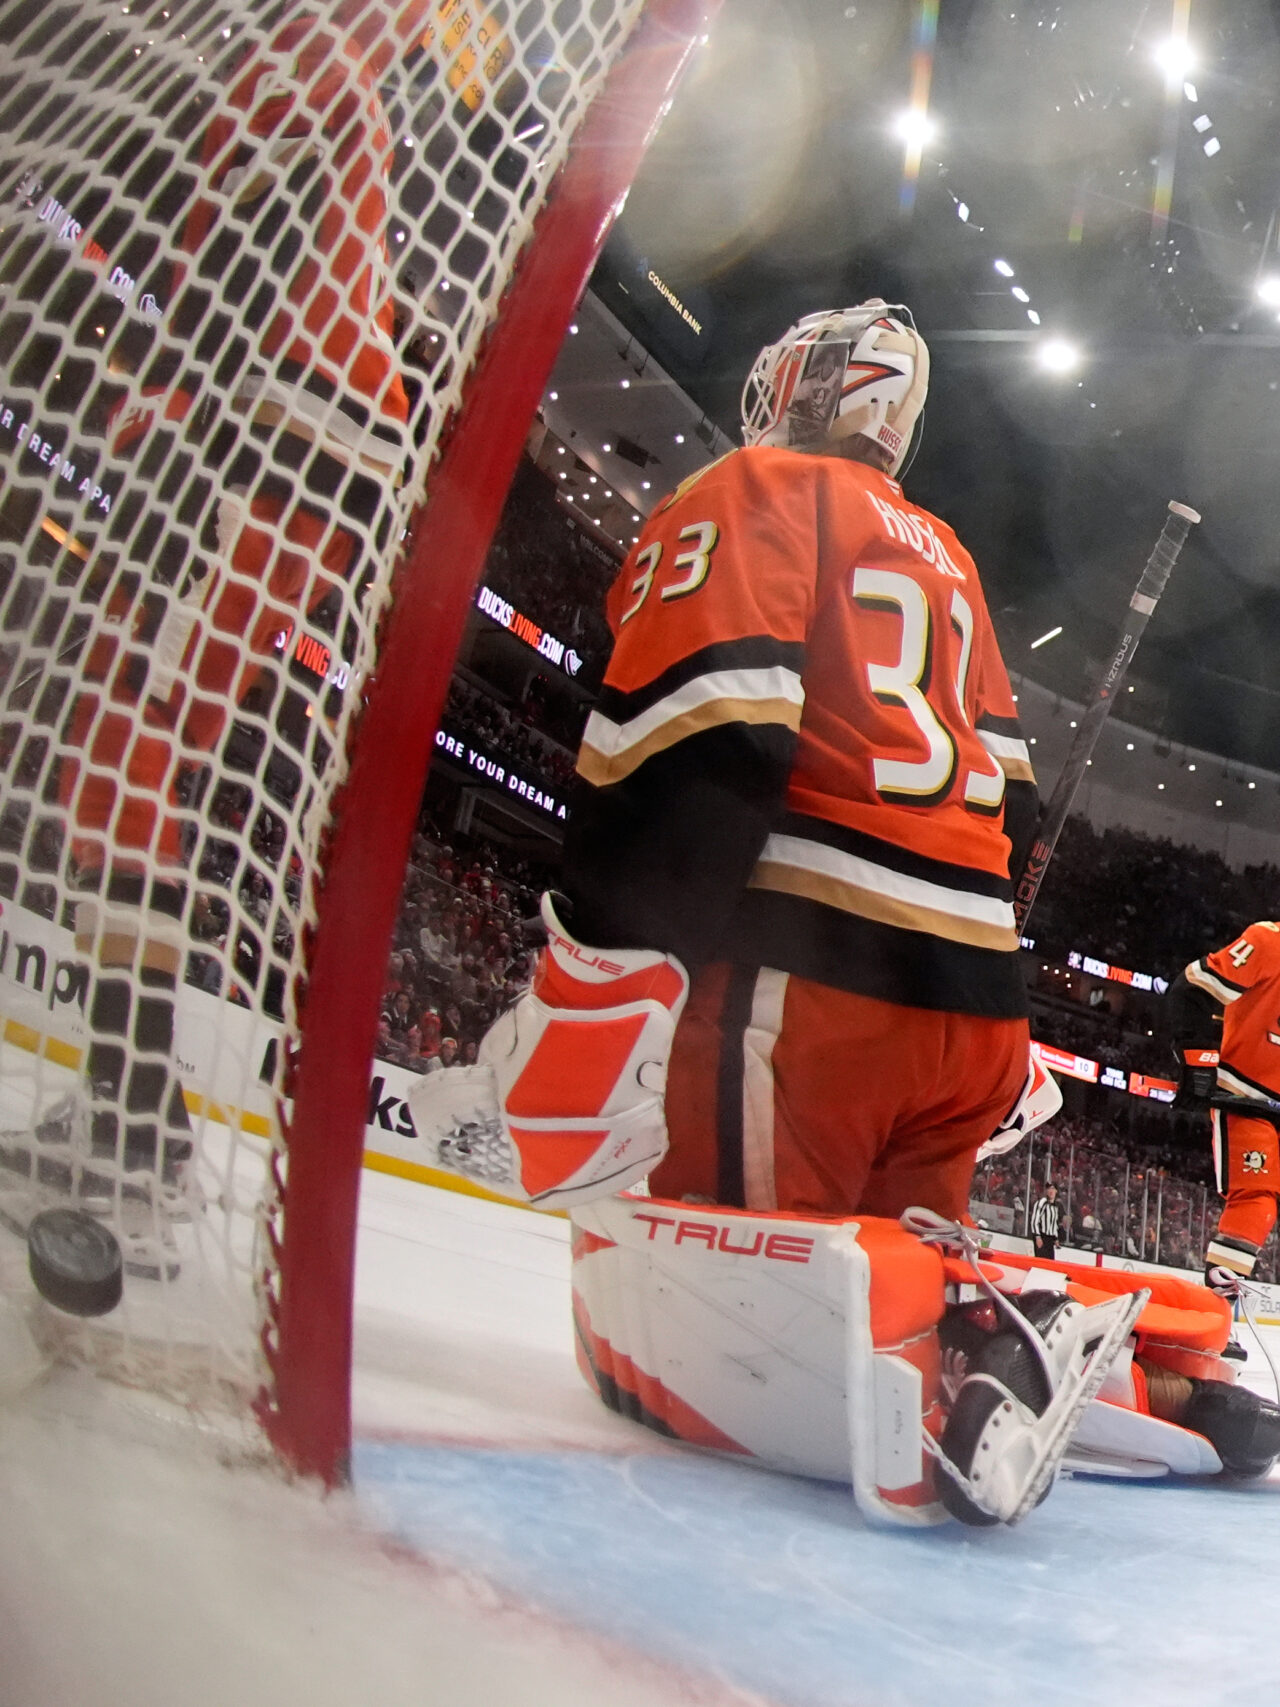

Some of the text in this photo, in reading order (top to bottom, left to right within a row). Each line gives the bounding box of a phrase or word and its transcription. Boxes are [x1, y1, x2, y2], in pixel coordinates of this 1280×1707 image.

[648, 270, 702, 335] COLUMBIA BANK
[621, 520, 718, 626] 33
[477, 586, 565, 665] DUCKSLIVING.COM
[468, 750, 505, 783] YOUR
[508, 775, 554, 812] DREAM
[1013, 839, 1049, 926] MOKE
[1229, 939, 1255, 968] 4
[632, 1213, 815, 1264] TRUE
